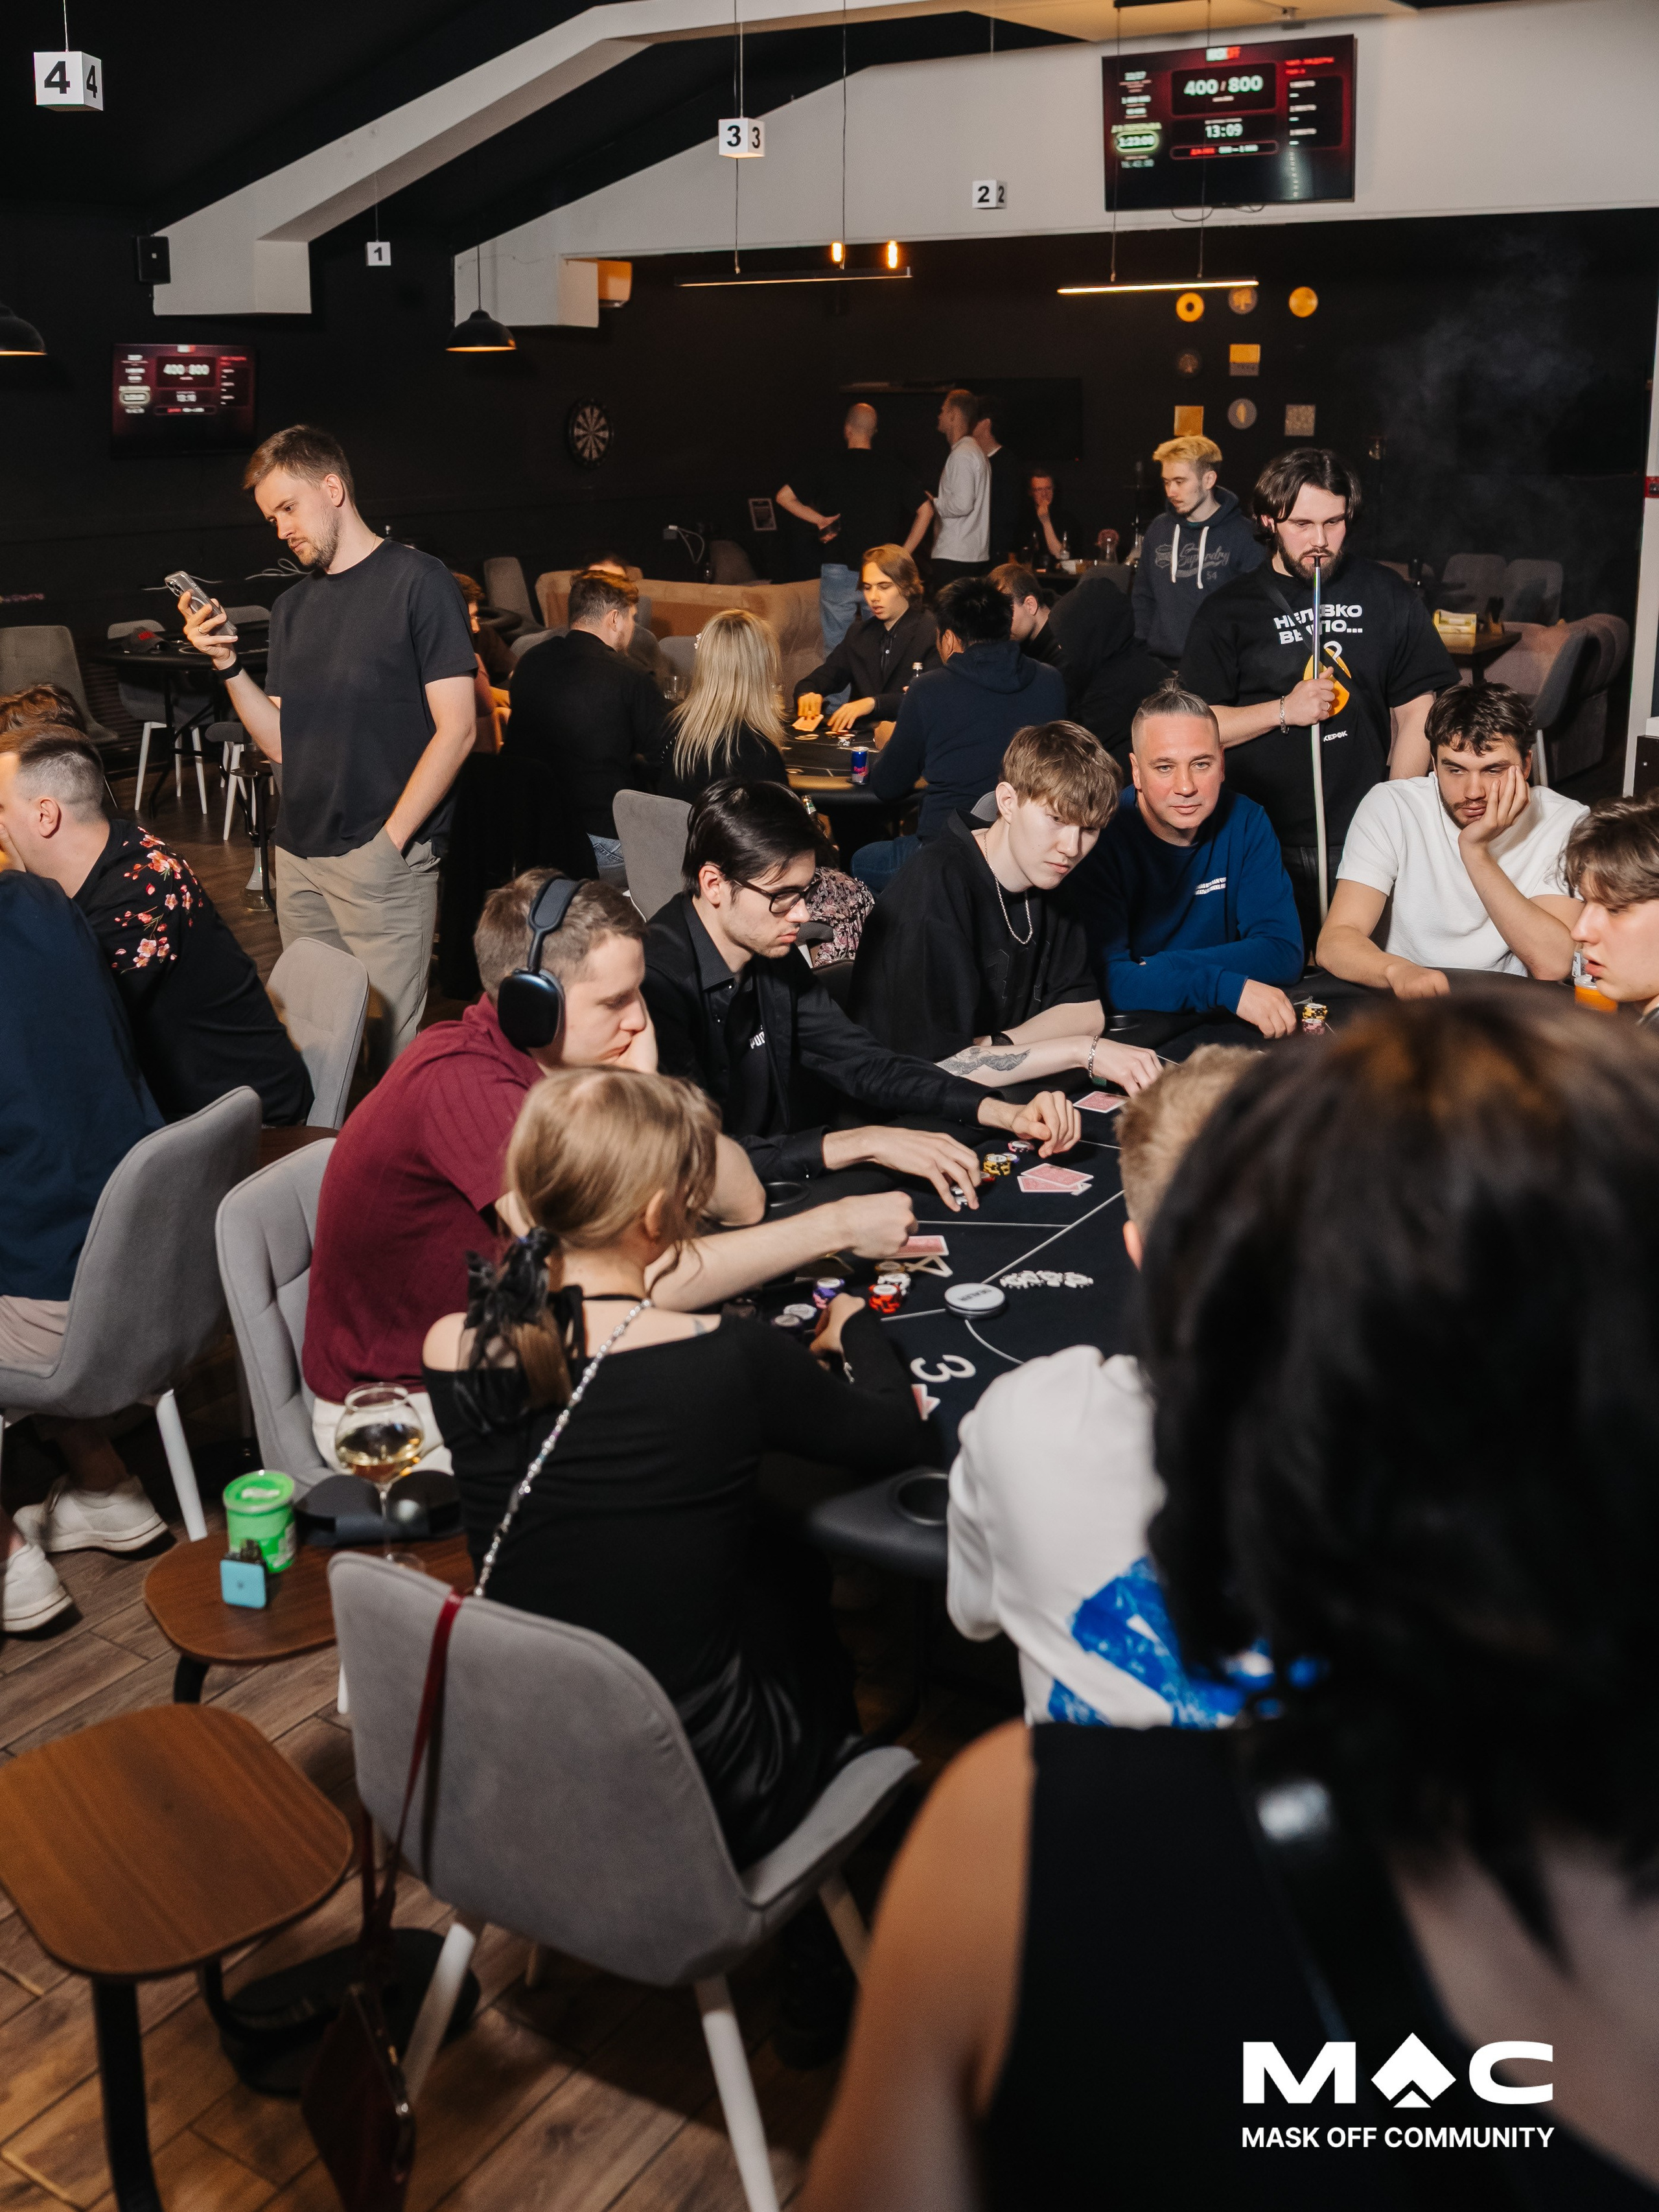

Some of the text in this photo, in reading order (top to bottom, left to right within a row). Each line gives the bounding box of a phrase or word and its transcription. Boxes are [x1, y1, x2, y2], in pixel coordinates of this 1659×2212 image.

[44, 60, 71, 94] 4
[86, 65, 98, 99] 4
[1183, 78, 1219, 96] 400
[1227, 75, 1264, 93] 800
[726, 125, 741, 147] 3
[752, 126, 761, 148] 3
[977, 185, 990, 203] 2
[998, 185, 1005, 203] 2
[374, 247, 382, 261] 1
[1178, 542, 1231, 569] Suprdry
[909, 1354, 977, 1383] 3
